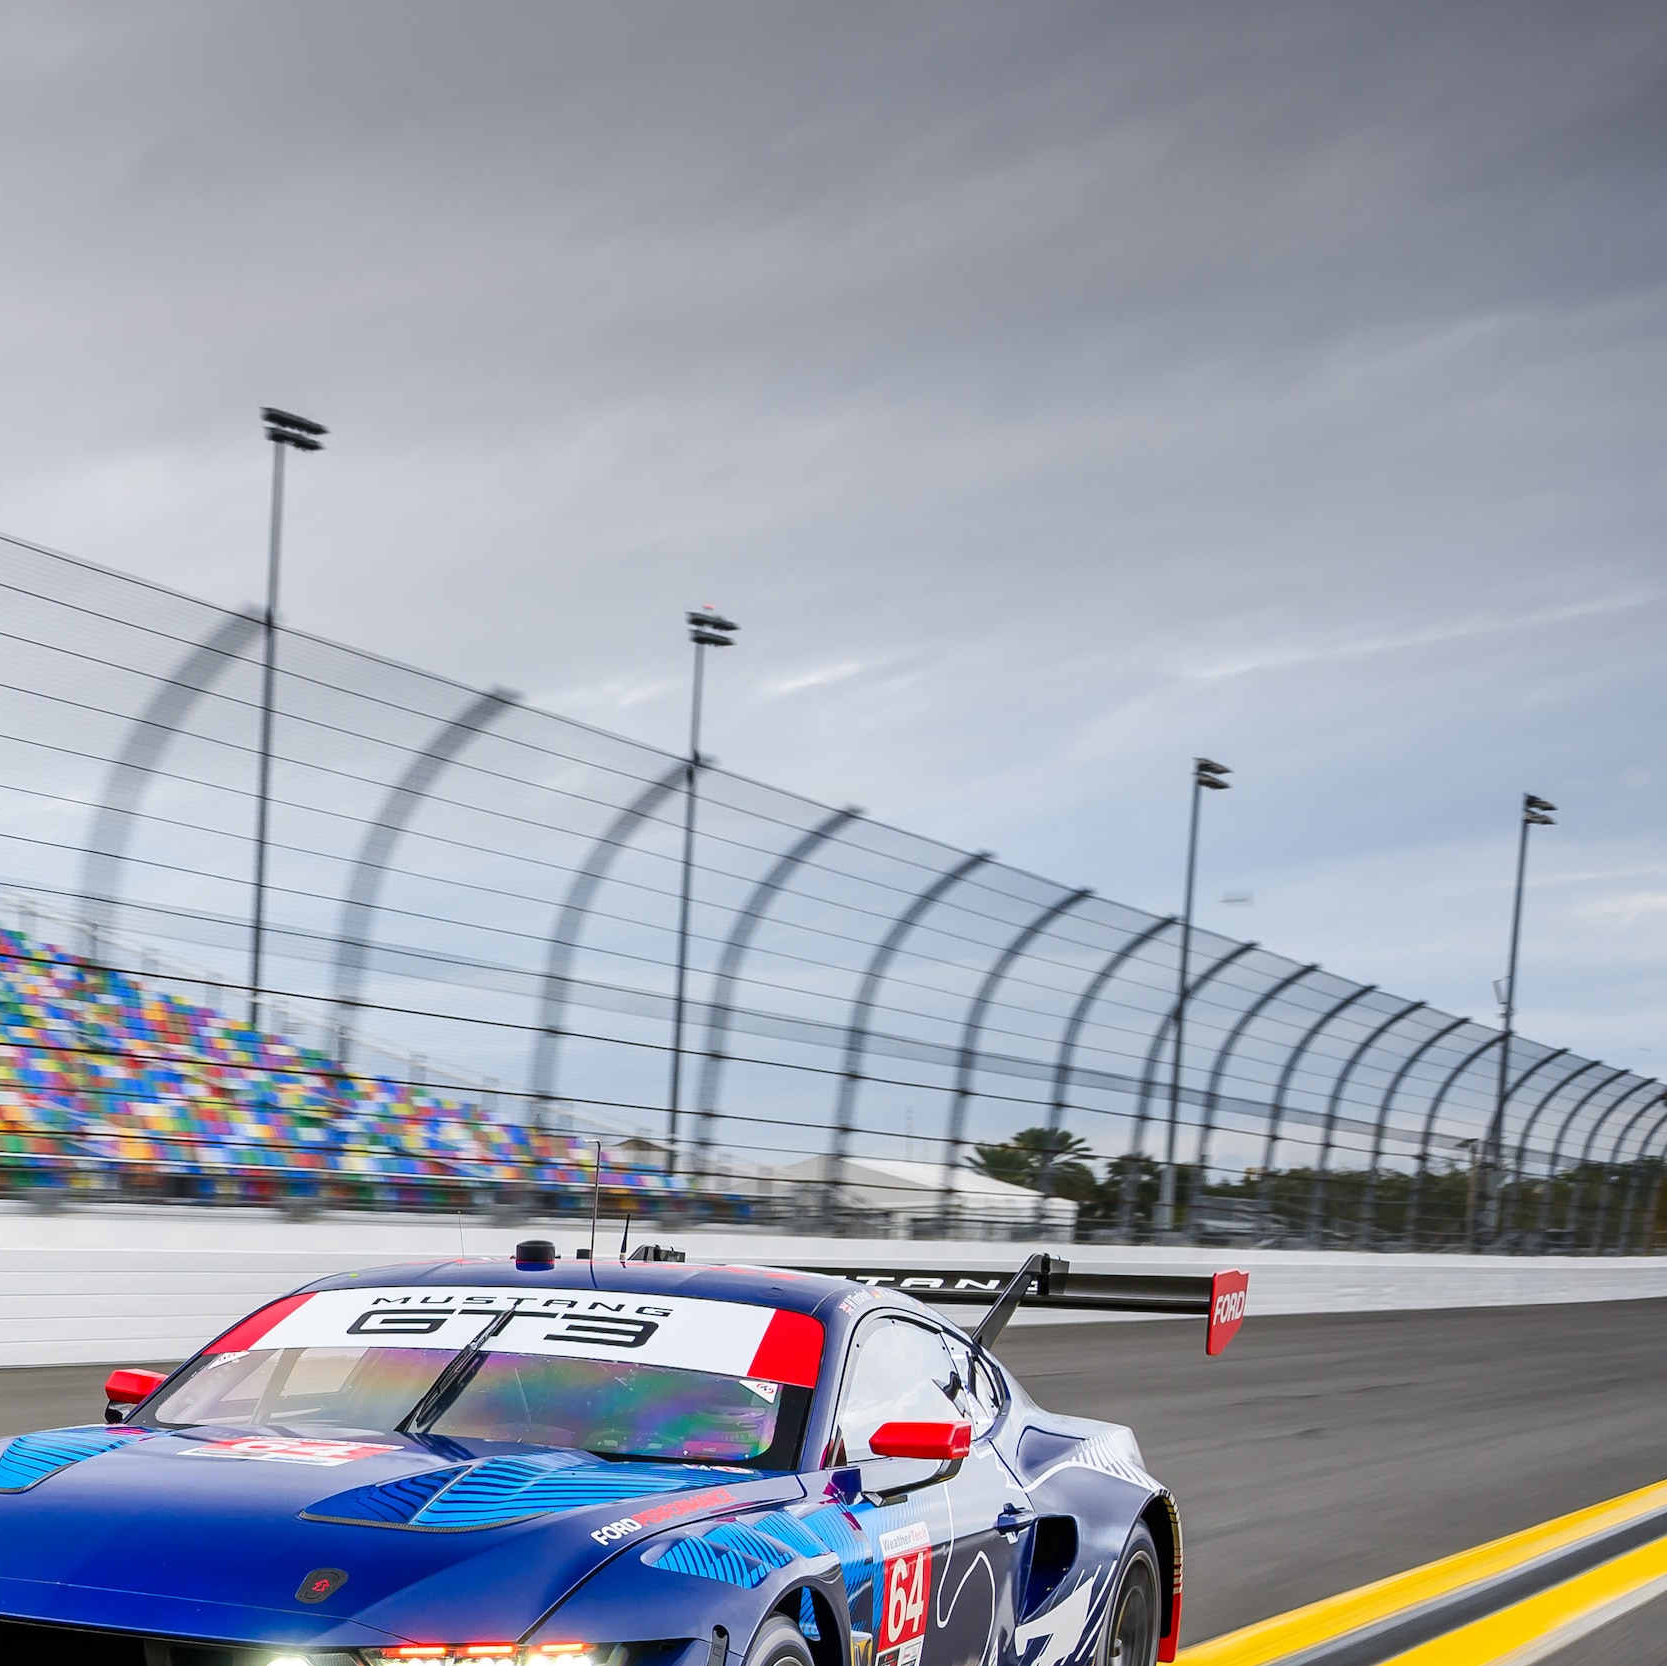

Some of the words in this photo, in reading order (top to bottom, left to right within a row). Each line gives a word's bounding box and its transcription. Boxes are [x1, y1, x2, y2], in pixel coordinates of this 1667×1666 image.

[372, 1296, 674, 1317] MUSTANG
[1213, 1291, 1247, 1326] FORD
[347, 1309, 659, 1348] GT3
[882, 1525, 928, 1551] WeatherTech
[887, 1551, 924, 1643] 64
